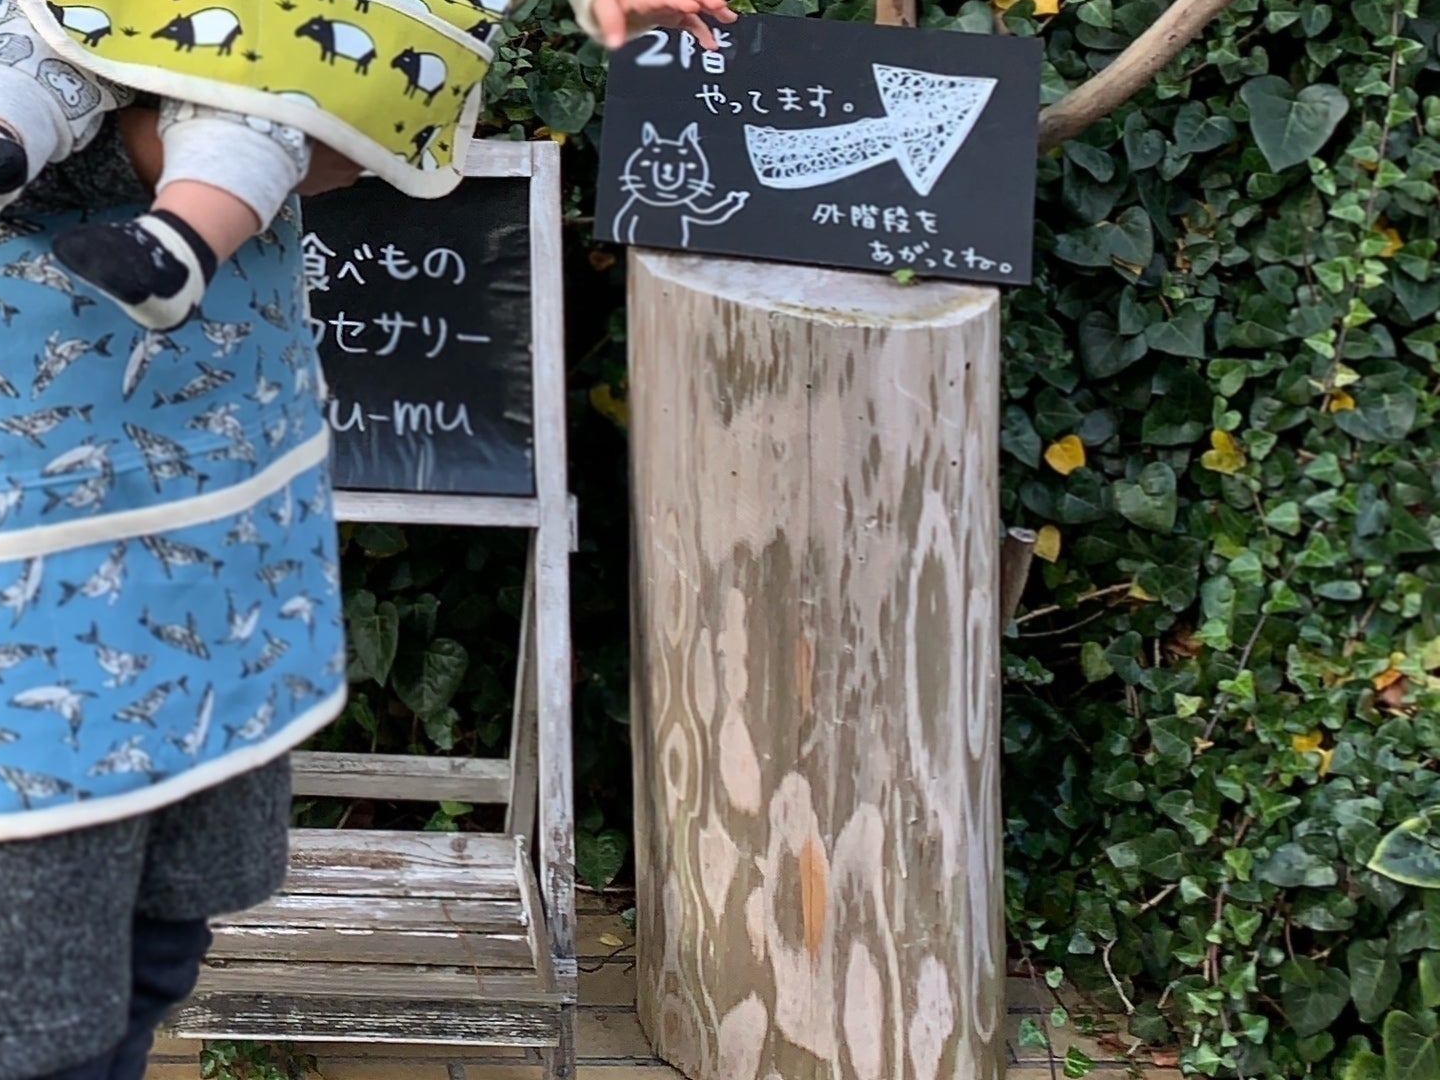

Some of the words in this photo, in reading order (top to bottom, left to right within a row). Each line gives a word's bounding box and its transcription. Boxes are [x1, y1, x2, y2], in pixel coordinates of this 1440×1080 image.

[635, 28, 733, 74] 2階
[695, 84, 855, 118] やってます。
[812, 204, 939, 234] 外階段を
[868, 240, 1013, 274] あがってね。
